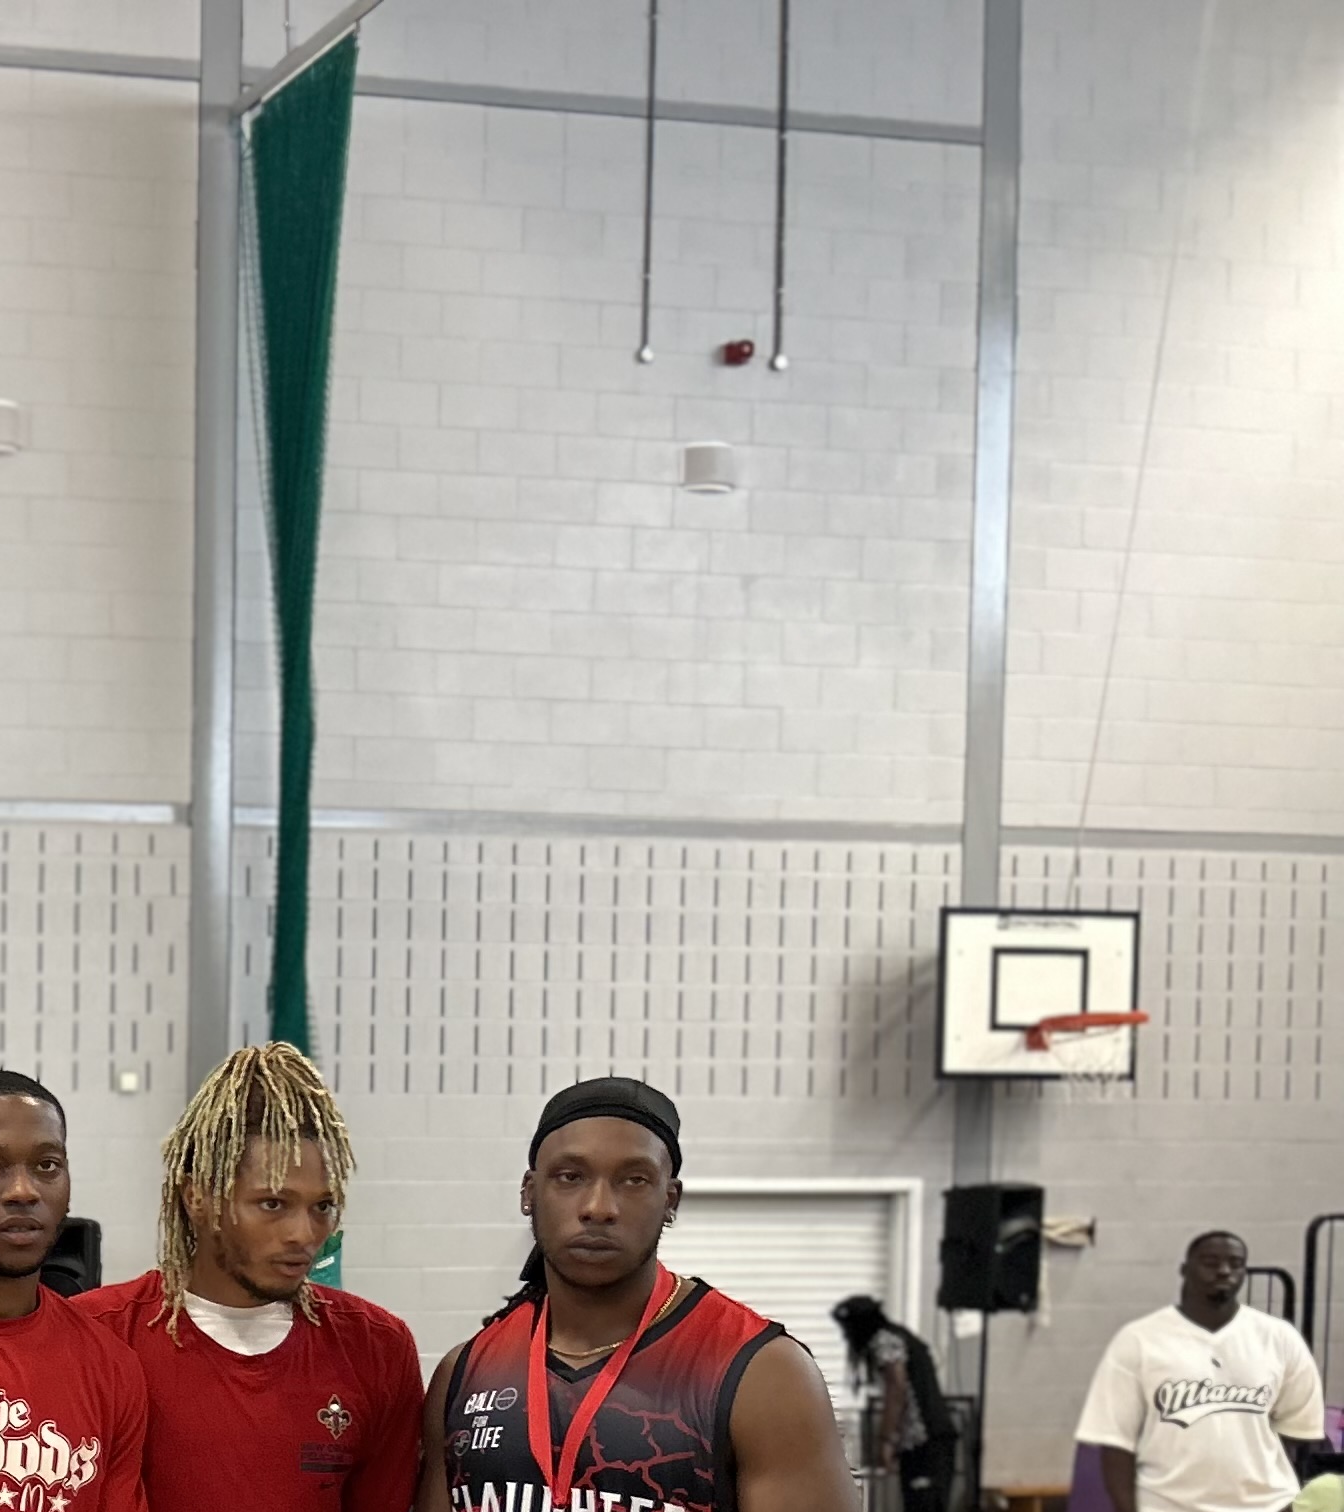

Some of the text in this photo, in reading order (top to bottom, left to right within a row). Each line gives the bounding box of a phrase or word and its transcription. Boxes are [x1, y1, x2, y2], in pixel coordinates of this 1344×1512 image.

[464, 1390, 498, 1415] BALL
[1154, 1378, 1272, 1417] Miami
[471, 1427, 504, 1449] LIFE
